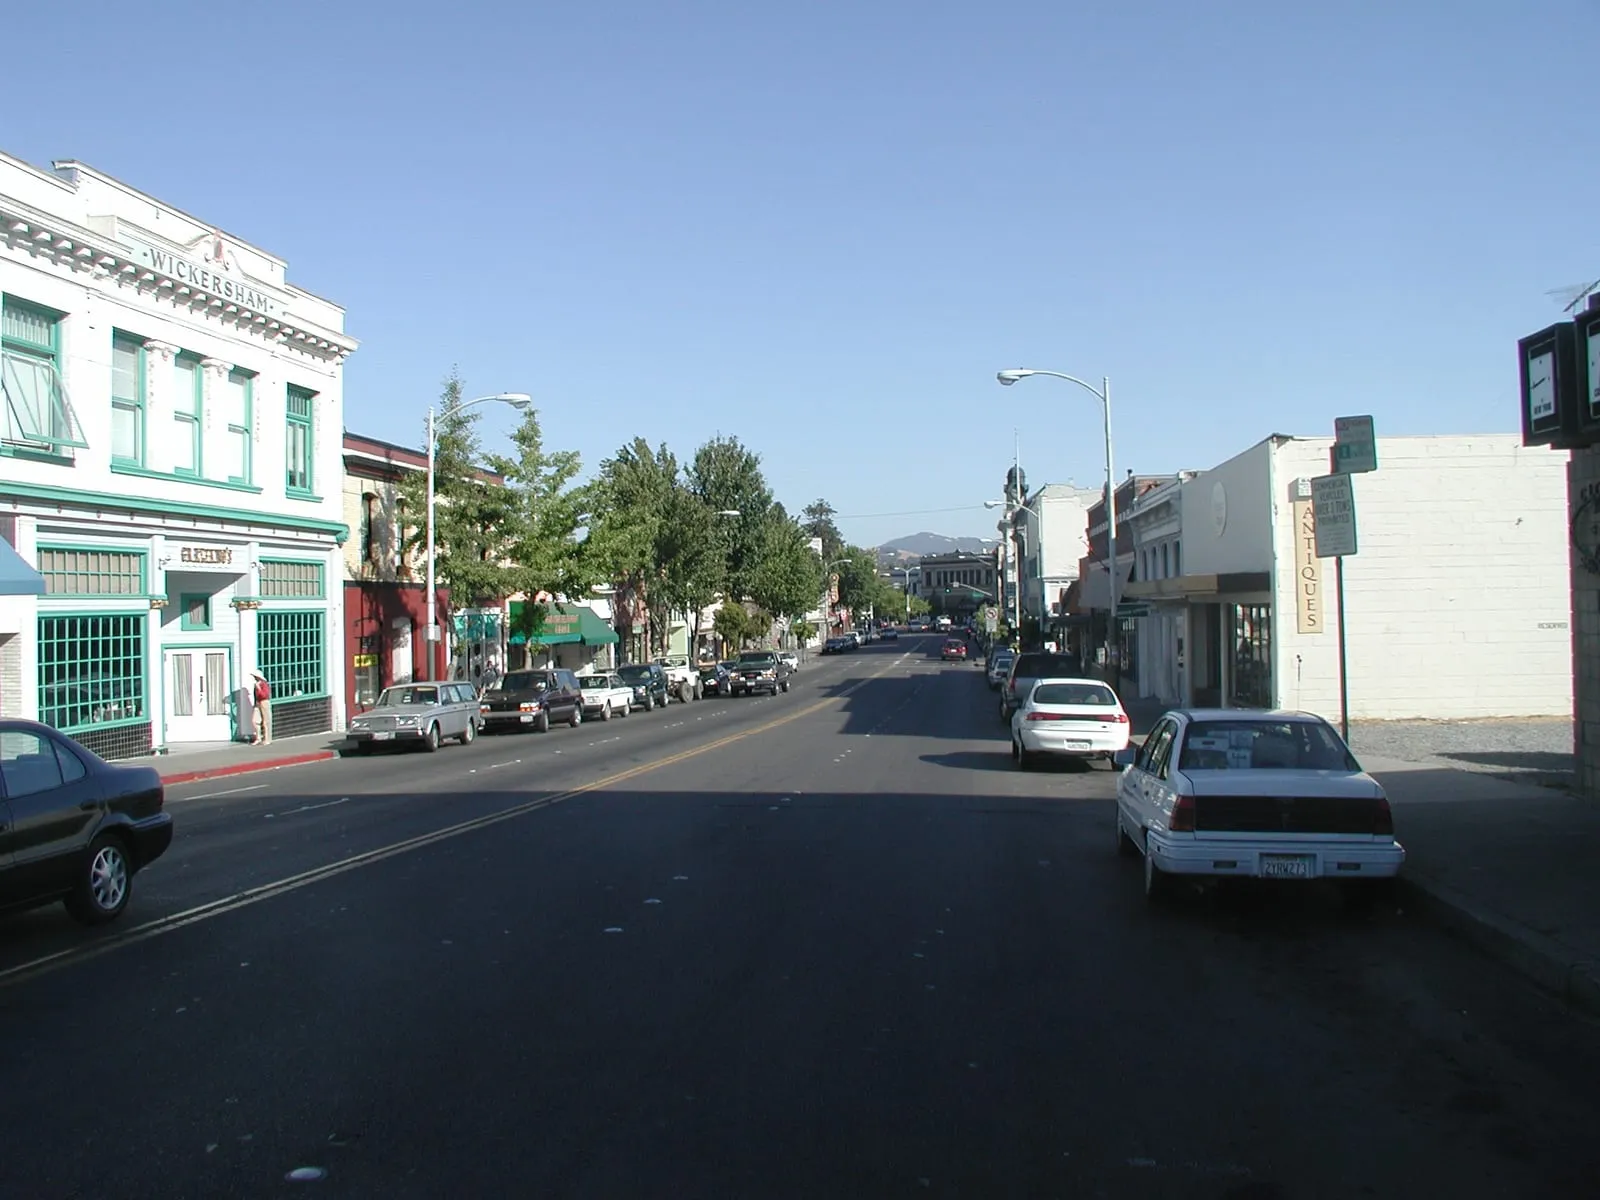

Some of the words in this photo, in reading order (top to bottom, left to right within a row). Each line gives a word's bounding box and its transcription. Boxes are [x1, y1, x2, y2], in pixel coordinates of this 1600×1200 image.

[150, 248, 268, 313] WICKERSHAM
[1319, 489, 1345, 502] VEHICLES
[1336, 498, 1351, 513] TONS
[1301, 506, 1318, 627] ANTIQUES
[1265, 861, 1307, 876] 2YRW273
